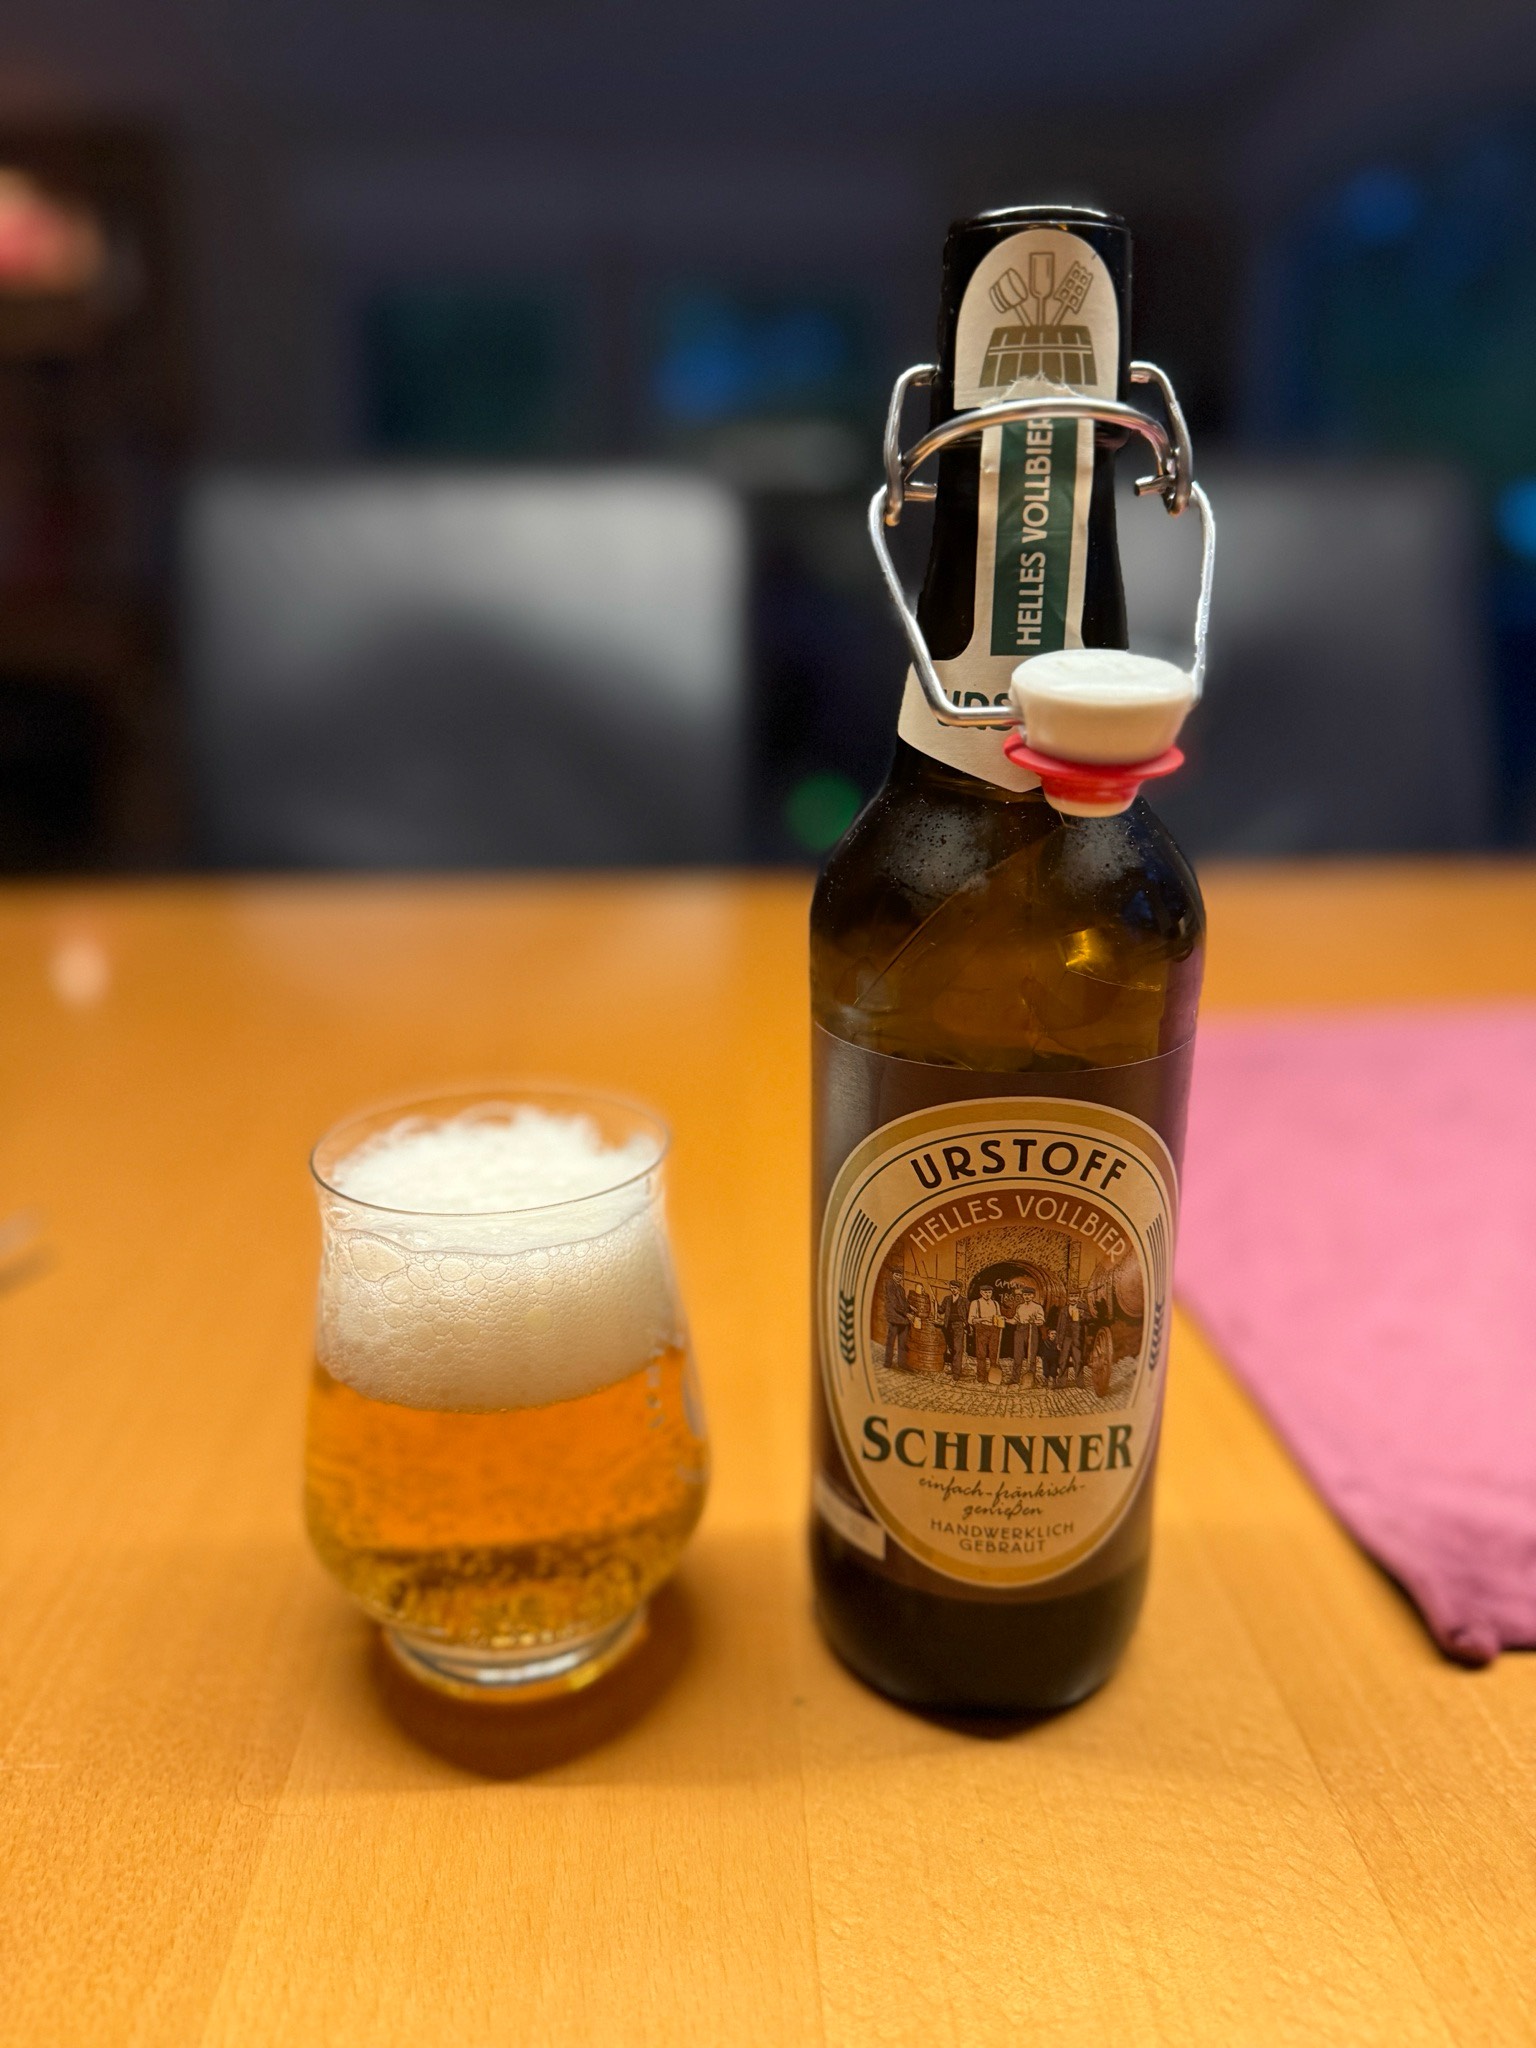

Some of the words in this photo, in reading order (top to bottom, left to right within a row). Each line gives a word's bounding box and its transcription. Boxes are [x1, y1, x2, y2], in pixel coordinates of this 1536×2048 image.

[1022, 418, 1054, 544] VOLLBIER
[1016, 552, 1046, 645] HELLES
[910, 1138, 1127, 1190] URSTOFF
[909, 1197, 1003, 1253] HELLES
[1015, 1195, 1126, 1263] VOLLBIER
[862, 1415, 1132, 1474] SCHINNER
[930, 1518, 1075, 1540] HANDWERKLICH
[962, 1499, 1043, 1520] genießen
[959, 1537, 1046, 1555] GEBRAUT
